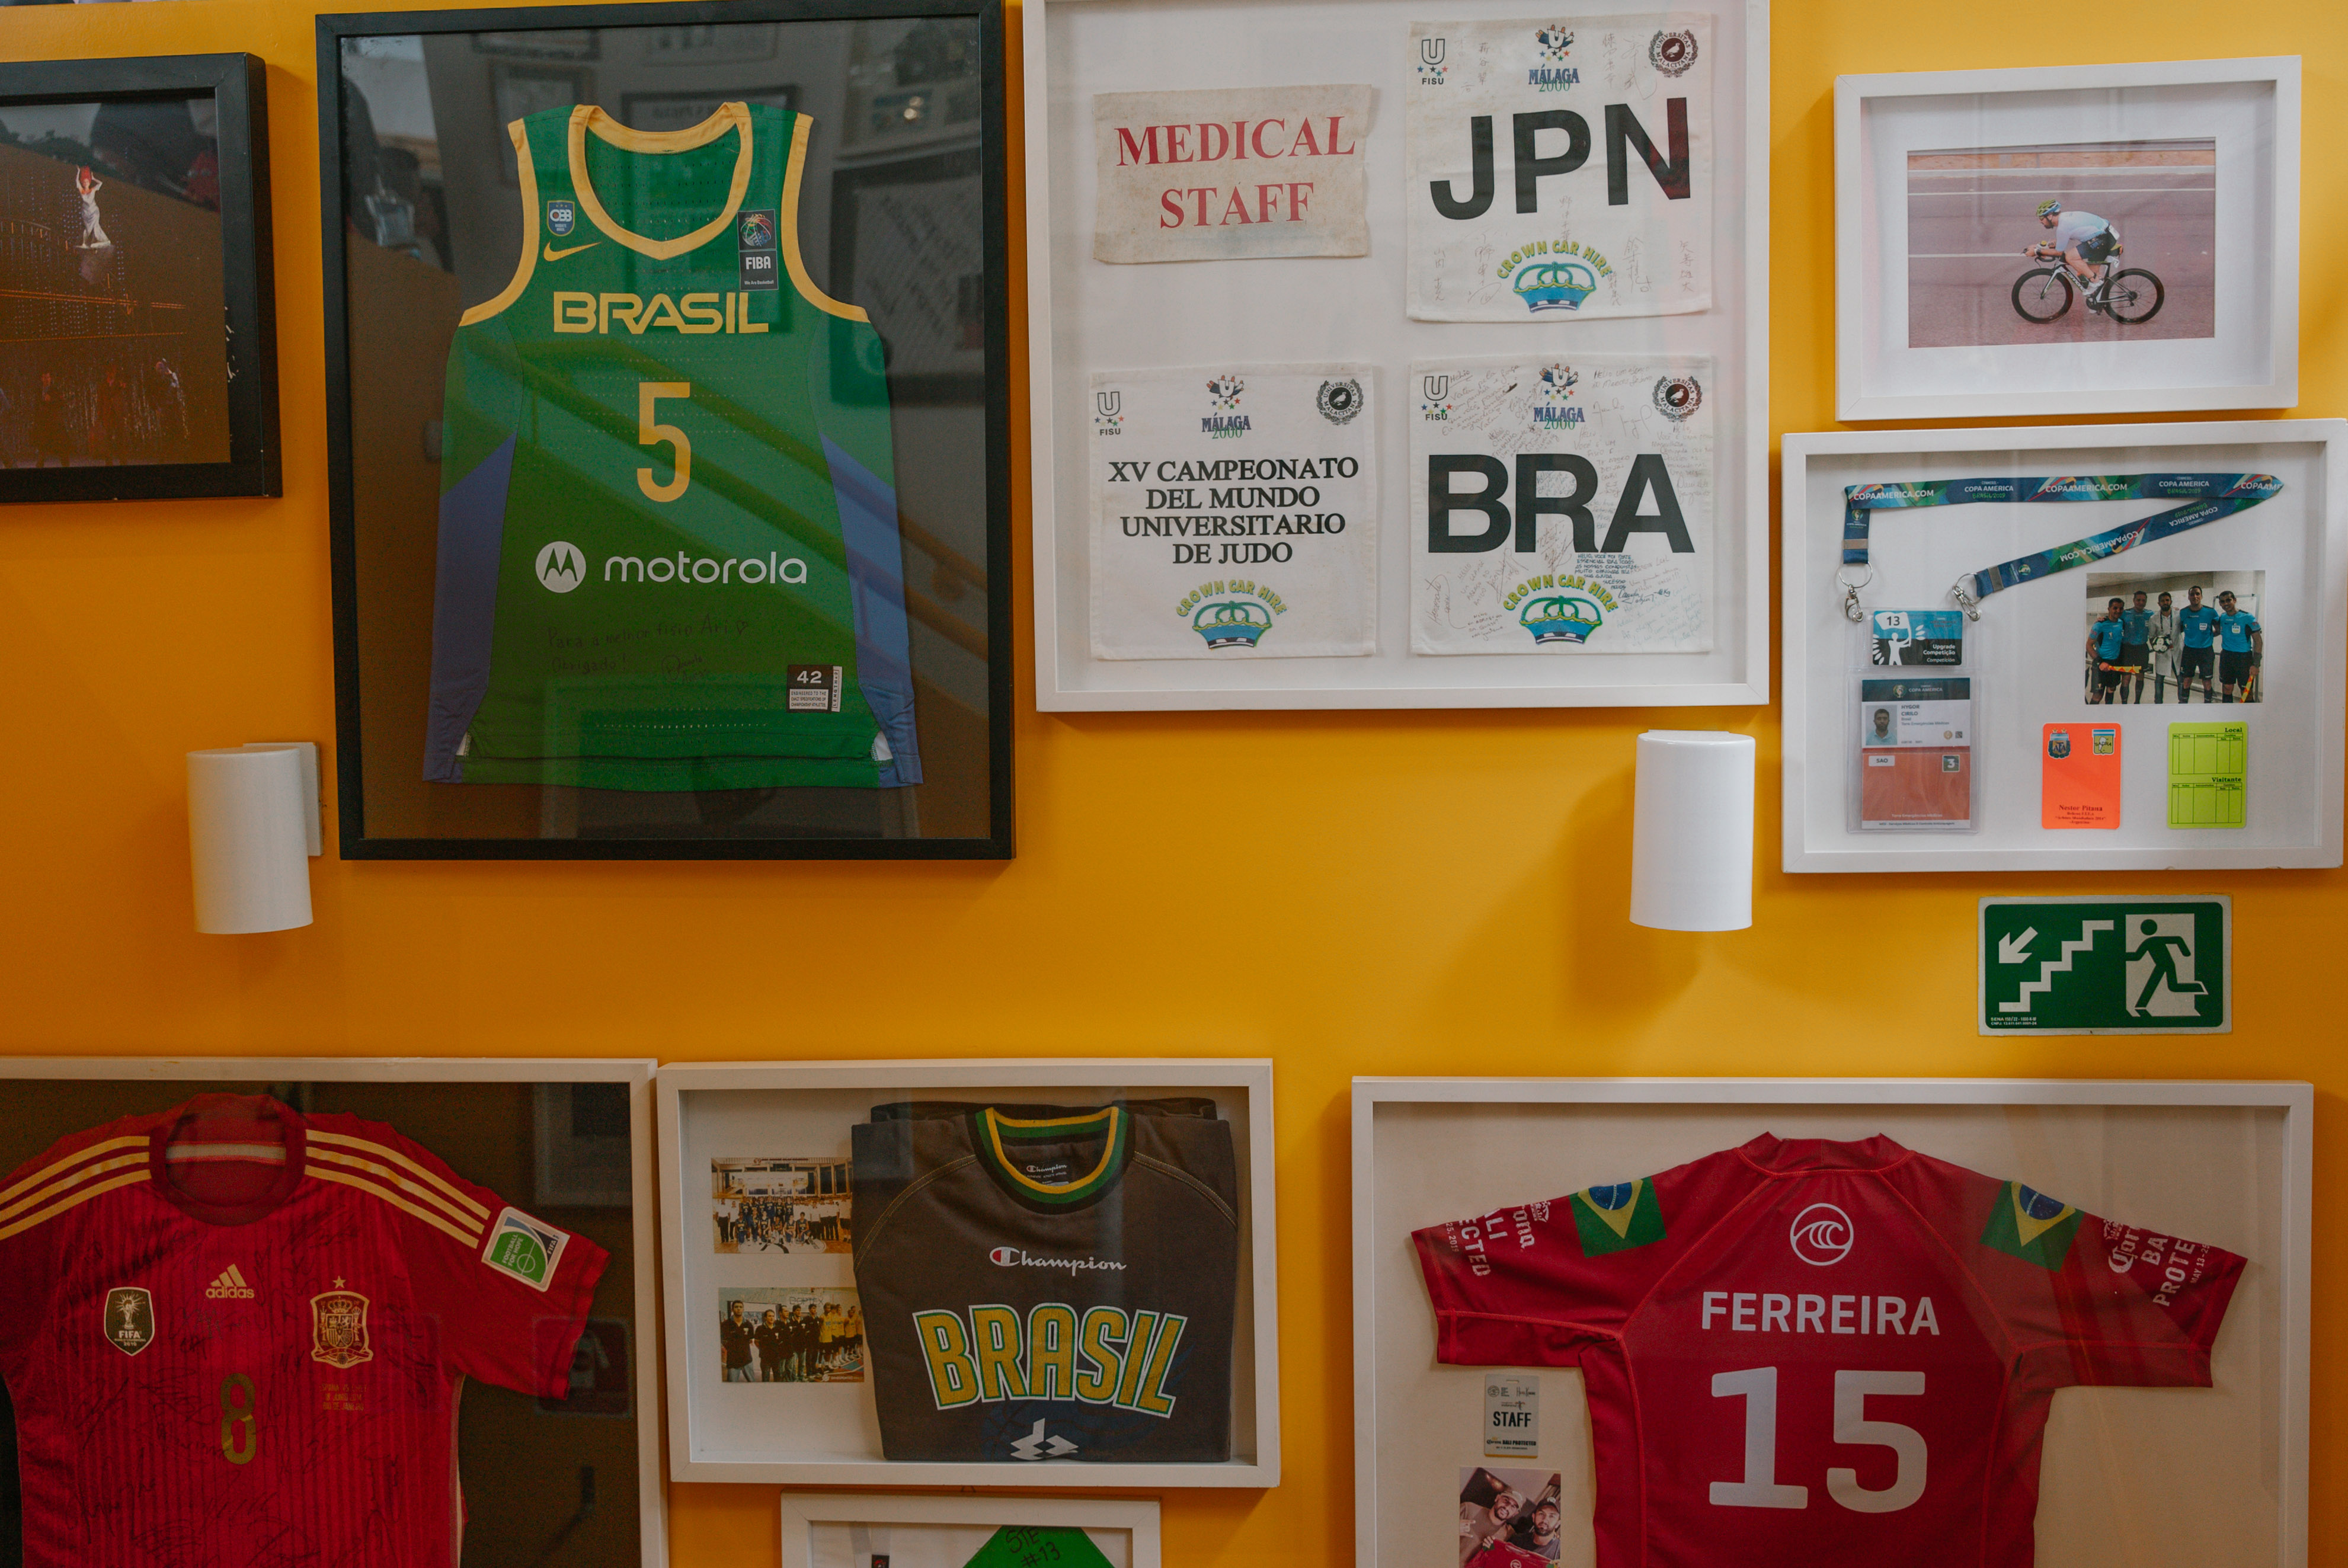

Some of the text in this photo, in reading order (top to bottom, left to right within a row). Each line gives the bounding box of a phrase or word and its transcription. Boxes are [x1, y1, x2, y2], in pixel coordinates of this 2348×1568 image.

[1656, 32, 1691, 49] UNIVERSITAS
[1656, 50, 1691, 68] MALACITANA
[1422, 77, 1444, 85] FISU
[1528, 65, 1580, 85] MÁLAGA
[1539, 79, 1570, 92] 2000
[1114, 116, 1355, 167] MEDICAL
[1430, 97, 1691, 220] JPN
[1160, 182, 1313, 229] STAFF
[746, 256, 771, 270] FIBA
[1497, 239, 1547, 279] CROWN
[1552, 240, 1579, 255] CAR
[1582, 247, 1613, 279] HIRE
[554, 291, 769, 335] BRASIL
[1323, 381, 1357, 398] UNIVERSITAS
[1659, 379, 1695, 396] UNIVERSITAS
[1323, 400, 1358, 415] MALACITANA
[1533, 402, 1585, 423] MÁLAGA
[1659, 395, 1696, 414] MALACITANA
[1201, 413, 1251, 433] MÁLAGA
[1425, 412, 1448, 421] FISU
[1543, 417, 1576, 431] 2000
[1099, 427, 1121, 436] FISU
[1211, 427, 1243, 440] 2000
[636, 382, 691, 503] 5
[1108, 456, 1359, 482] XV CAMPEONATO
[1146, 486, 1320, 510] DEL MUNDO
[1854, 489, 1934, 501] COPAAMERICA.COM
[2045, 483, 2127, 493] COPAAMERICA.COM
[1428, 453, 1695, 553] BRA
[1120, 513, 1346, 537] UNIVERSITARIO
[2169, 507, 2218, 526] COPA AMERICA
[1172, 542, 1293, 564] DE JUDO
[2060, 531, 2138, 562] COPAAMERICA.COM
[604, 551, 808, 584] motorola
[1176, 580, 1288, 617] CROWN CAR HIRE
[1502, 574, 1553, 612] CROWN
[1557, 574, 1586, 590] CAR
[1588, 581, 1619, 613] HIRE
[1887, 616, 1900, 626] 13
[797, 671, 822, 684] 42
[1947, 759, 1955, 768] 3
[1026, 1164, 1067, 1173] Champion
[503, 1234, 518, 1263] FOOTBALL
[508, 1237, 524, 1266] FOR HOPE
[547, 1241, 556, 1255] FIFA
[990, 1246, 1127, 1276] Champion
[2190, 1268, 2202, 1284] MAY
[206, 1286, 255, 1298] adidas
[1701, 1291, 1940, 1336] FERREIRA
[119, 1330, 140, 1339] FIFA
[913, 1303, 1187, 1418] BRASIL
[220, 1372, 257, 1464] 8
[1493, 1411, 1531, 1427] STAFF
[1709, 1366, 1928, 1513] 15
[1006, 1526, 1040, 1553] STE
[1021, 1541, 1060, 1567] #13
